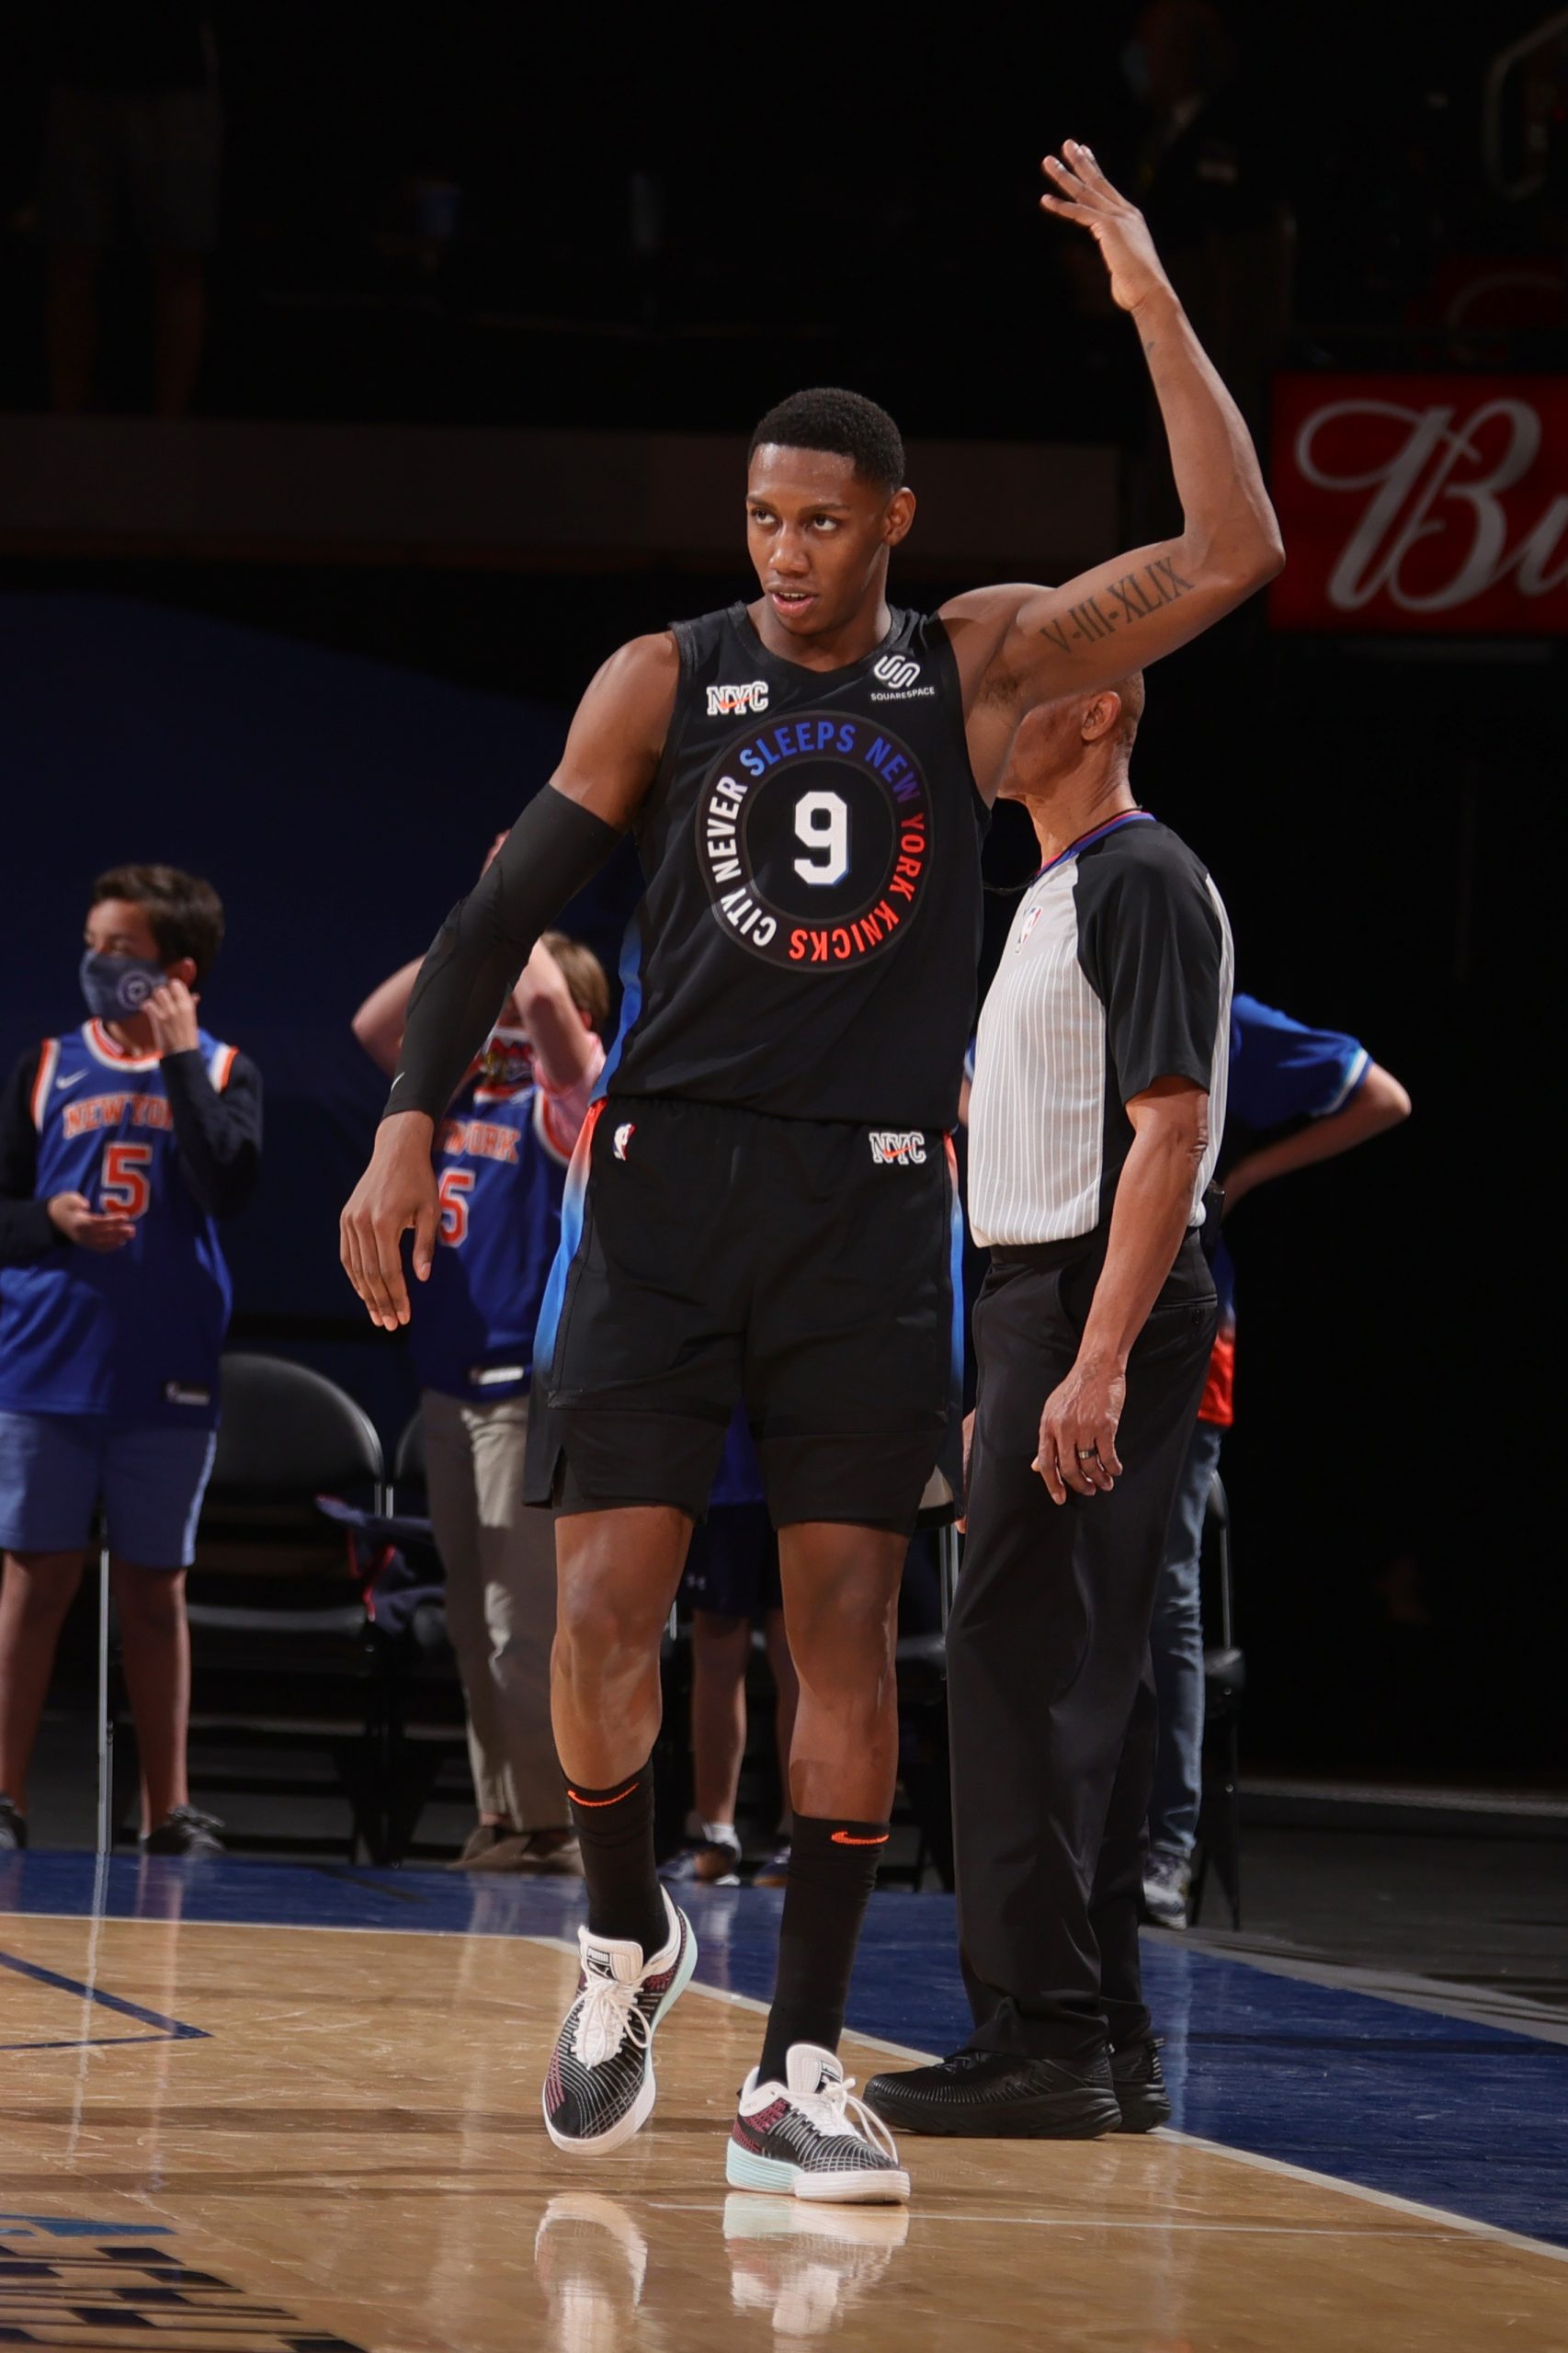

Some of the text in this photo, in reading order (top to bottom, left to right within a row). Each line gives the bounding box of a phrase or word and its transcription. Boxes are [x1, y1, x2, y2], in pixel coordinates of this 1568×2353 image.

[1040, 556, 1194, 654] V-III-XLIX
[707, 681, 768, 715] NYC
[870, 687, 936, 701] SQUARESPACE
[707, 722, 926, 961] CITY NEVER SLEEPS NEW YORK KNICKS
[794, 790, 851, 885] 9
[62, 1091, 128, 1140] NEW
[869, 1131, 926, 1165] NYC
[99, 1142, 153, 1221] 5
[437, 1166, 476, 1248] 5
